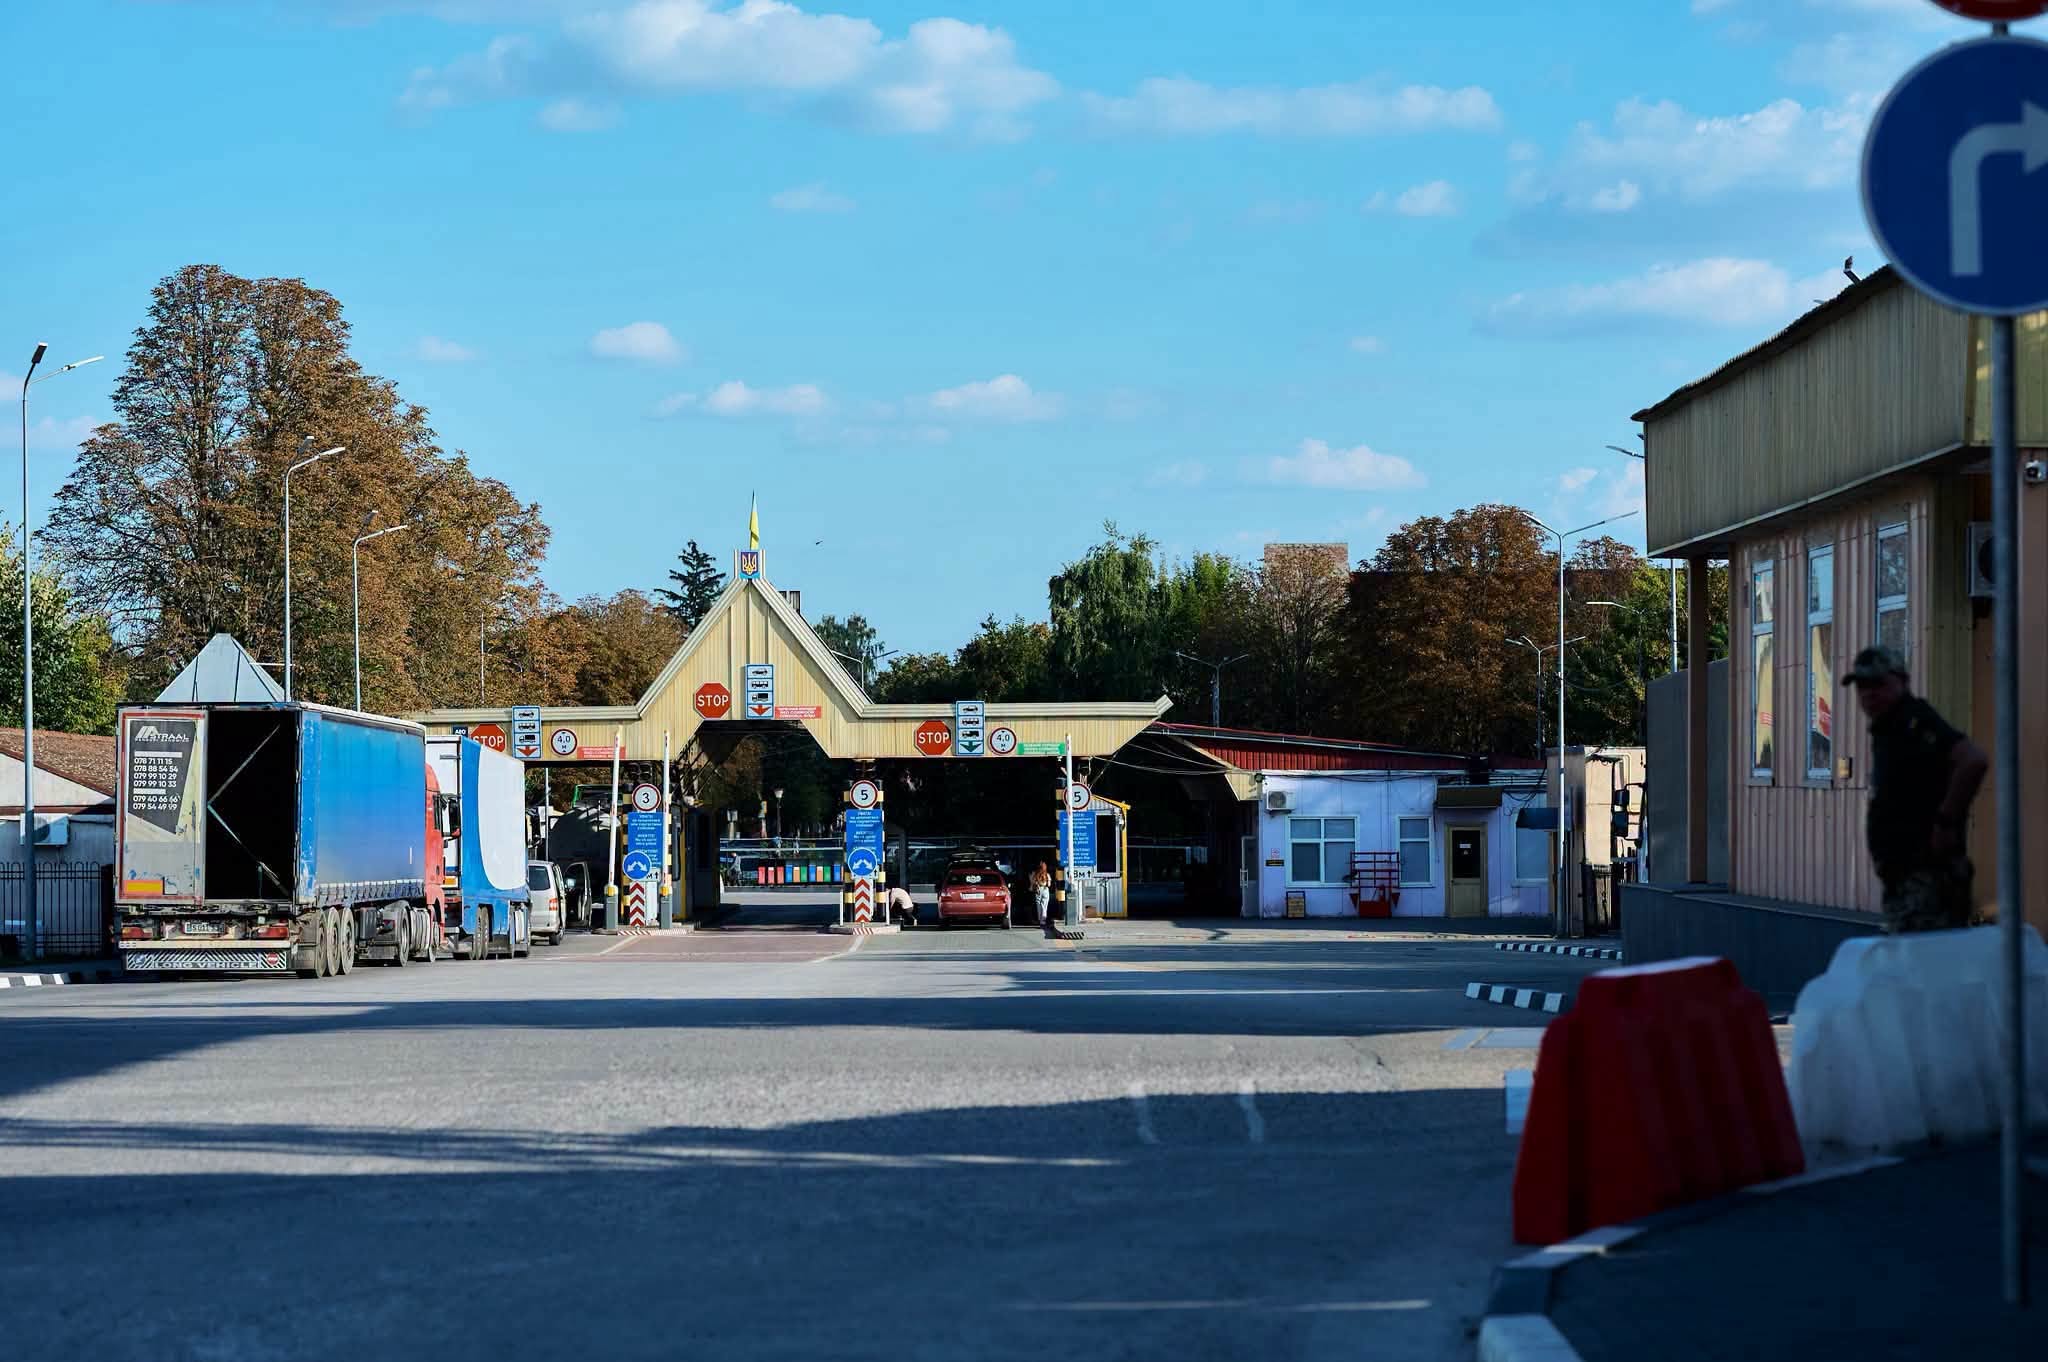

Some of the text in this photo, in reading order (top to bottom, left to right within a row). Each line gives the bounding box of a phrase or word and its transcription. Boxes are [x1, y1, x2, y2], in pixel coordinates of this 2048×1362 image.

[697, 695, 729, 707] STOP
[918, 731, 950, 744] STOP
[134, 780, 177, 788] 079 99 10 33
[642, 792, 650, 804] 3
[861, 790, 868, 801] 5
[1074, 791, 1081, 802] 5
[153, 961, 258, 969] LONG VEHICLE
